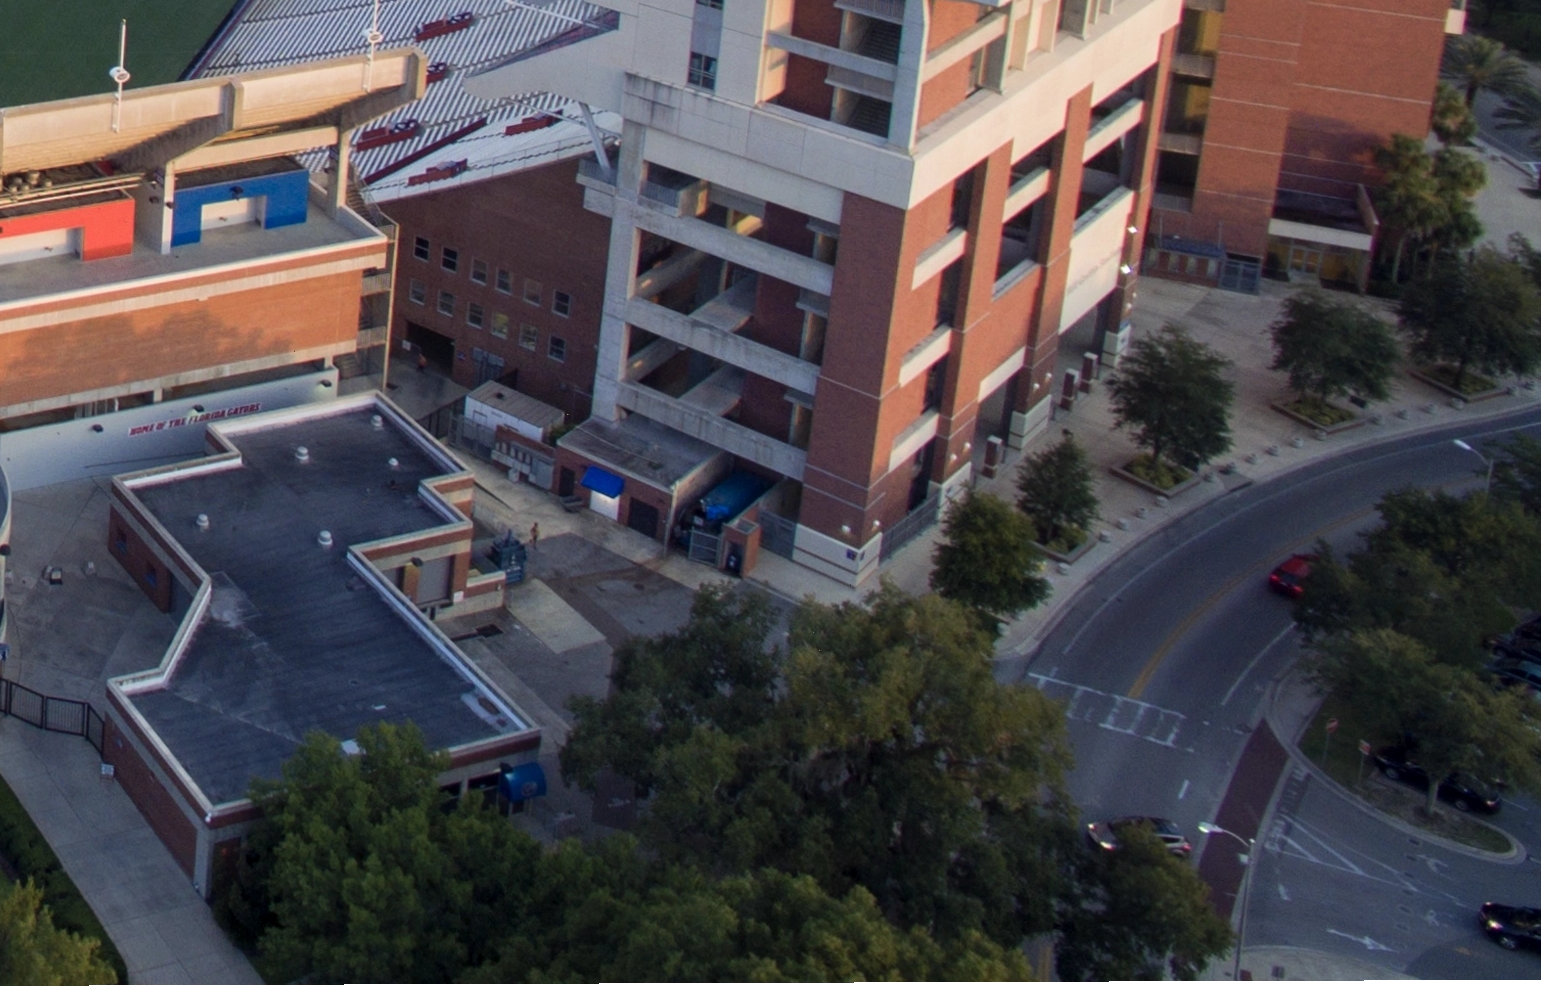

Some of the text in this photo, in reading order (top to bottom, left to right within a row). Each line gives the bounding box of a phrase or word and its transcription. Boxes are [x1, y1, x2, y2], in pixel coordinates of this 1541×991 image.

[129, 402, 261, 436] HOME OF THE FLORIDA GATORS
